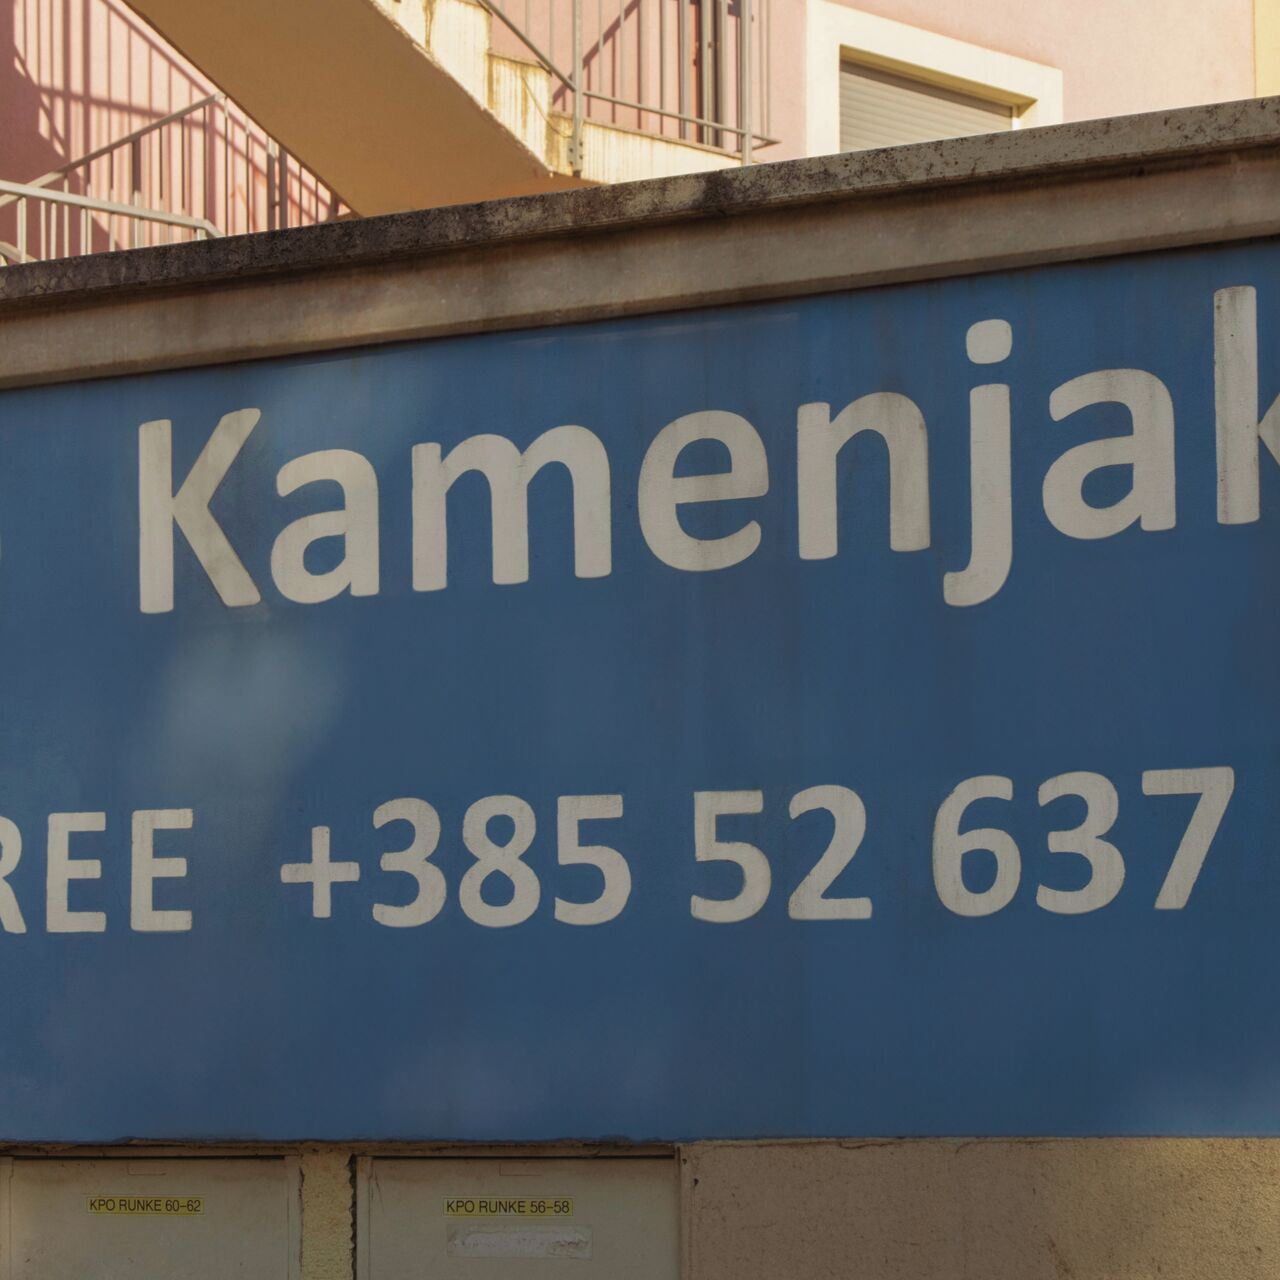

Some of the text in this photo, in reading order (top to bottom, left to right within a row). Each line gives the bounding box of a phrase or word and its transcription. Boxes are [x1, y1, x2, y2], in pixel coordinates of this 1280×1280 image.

[280, 793, 632, 928] +385
[690, 783, 874, 924] 52
[931, 765, 1235, 918] 637
[89, 1199, 201, 1212] KPO RUNKE 60-62
[446, 1200, 570, 1214] KPO RUNKE 56-58
